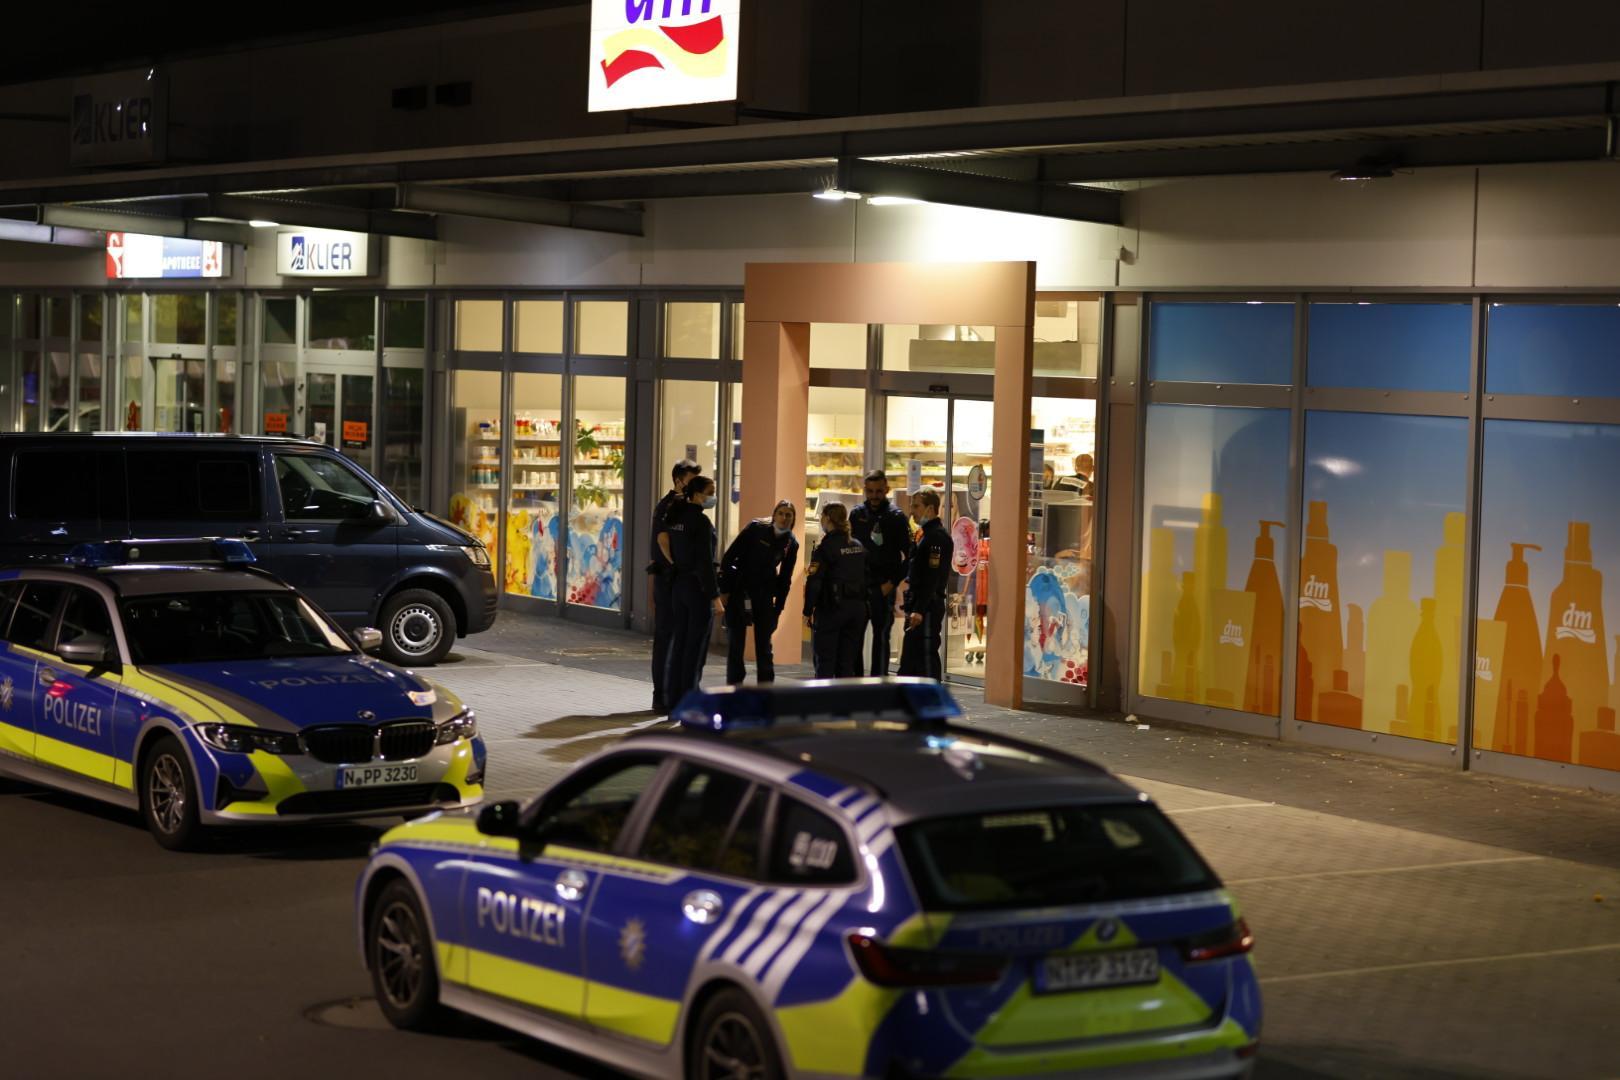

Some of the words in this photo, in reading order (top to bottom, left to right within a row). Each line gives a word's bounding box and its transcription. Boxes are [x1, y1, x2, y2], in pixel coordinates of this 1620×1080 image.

[95, 98, 152, 141] KLIER
[306, 242, 352, 270] KLIER
[1303, 575, 1329, 598] dm
[1223, 619, 1242, 637] dm
[1562, 602, 1593, 629] dm
[1476, 656, 1491, 671] m
[258, 674, 388, 690] POLIZEI
[44, 693, 101, 736] POLIZEI
[345, 771, 355, 785] N
[364, 768, 382, 784] PP
[384, 766, 417, 782] 3230
[477, 886, 566, 948] POLIZEI
